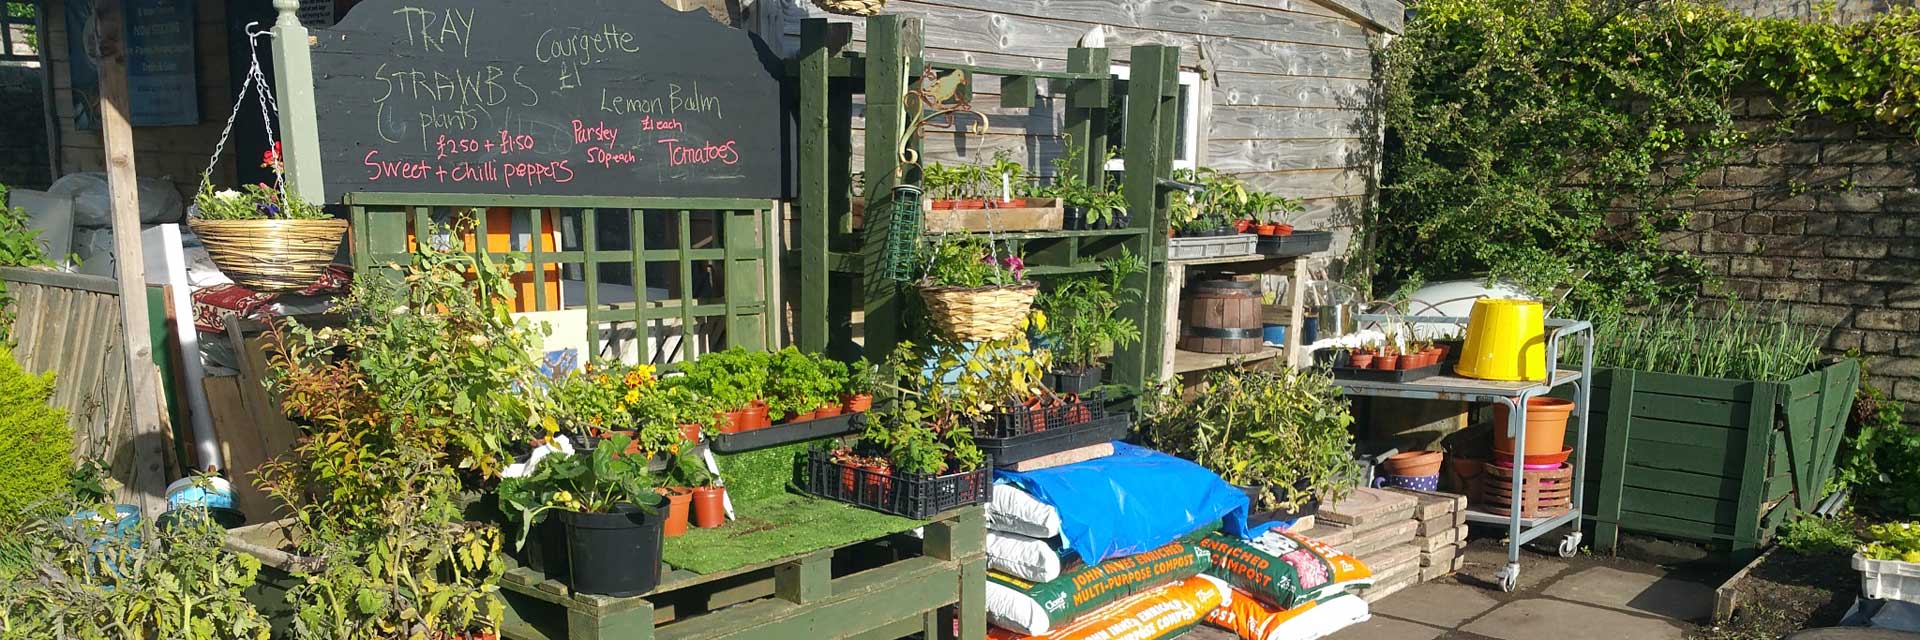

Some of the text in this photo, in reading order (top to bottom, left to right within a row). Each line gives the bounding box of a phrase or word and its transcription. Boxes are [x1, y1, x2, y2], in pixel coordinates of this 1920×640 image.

[393, 6, 475, 58] TRAY
[535, 23, 640, 66] Courgette
[373, 63, 539, 107] STRAWBS
[559, 61, 582, 90] £1
[600, 80, 722, 119] Lemon Balm
[572, 119, 618, 149] Parsley
[656, 119, 683, 133] each
[364, 150, 432, 181] Sweet
[503, 159, 574, 188] peppers
[658, 138, 740, 168] Tomatoes
[1072, 566, 1103, 591] JOHN
[1103, 556, 1136, 575] INNES
[1135, 542, 1185, 565] ENRICHED
[1200, 536, 1269, 571] ENRICHED
[1211, 553, 1272, 587] COMPOST
[1072, 554, 1194, 607] MULTI-PURPOSE COMPOST
